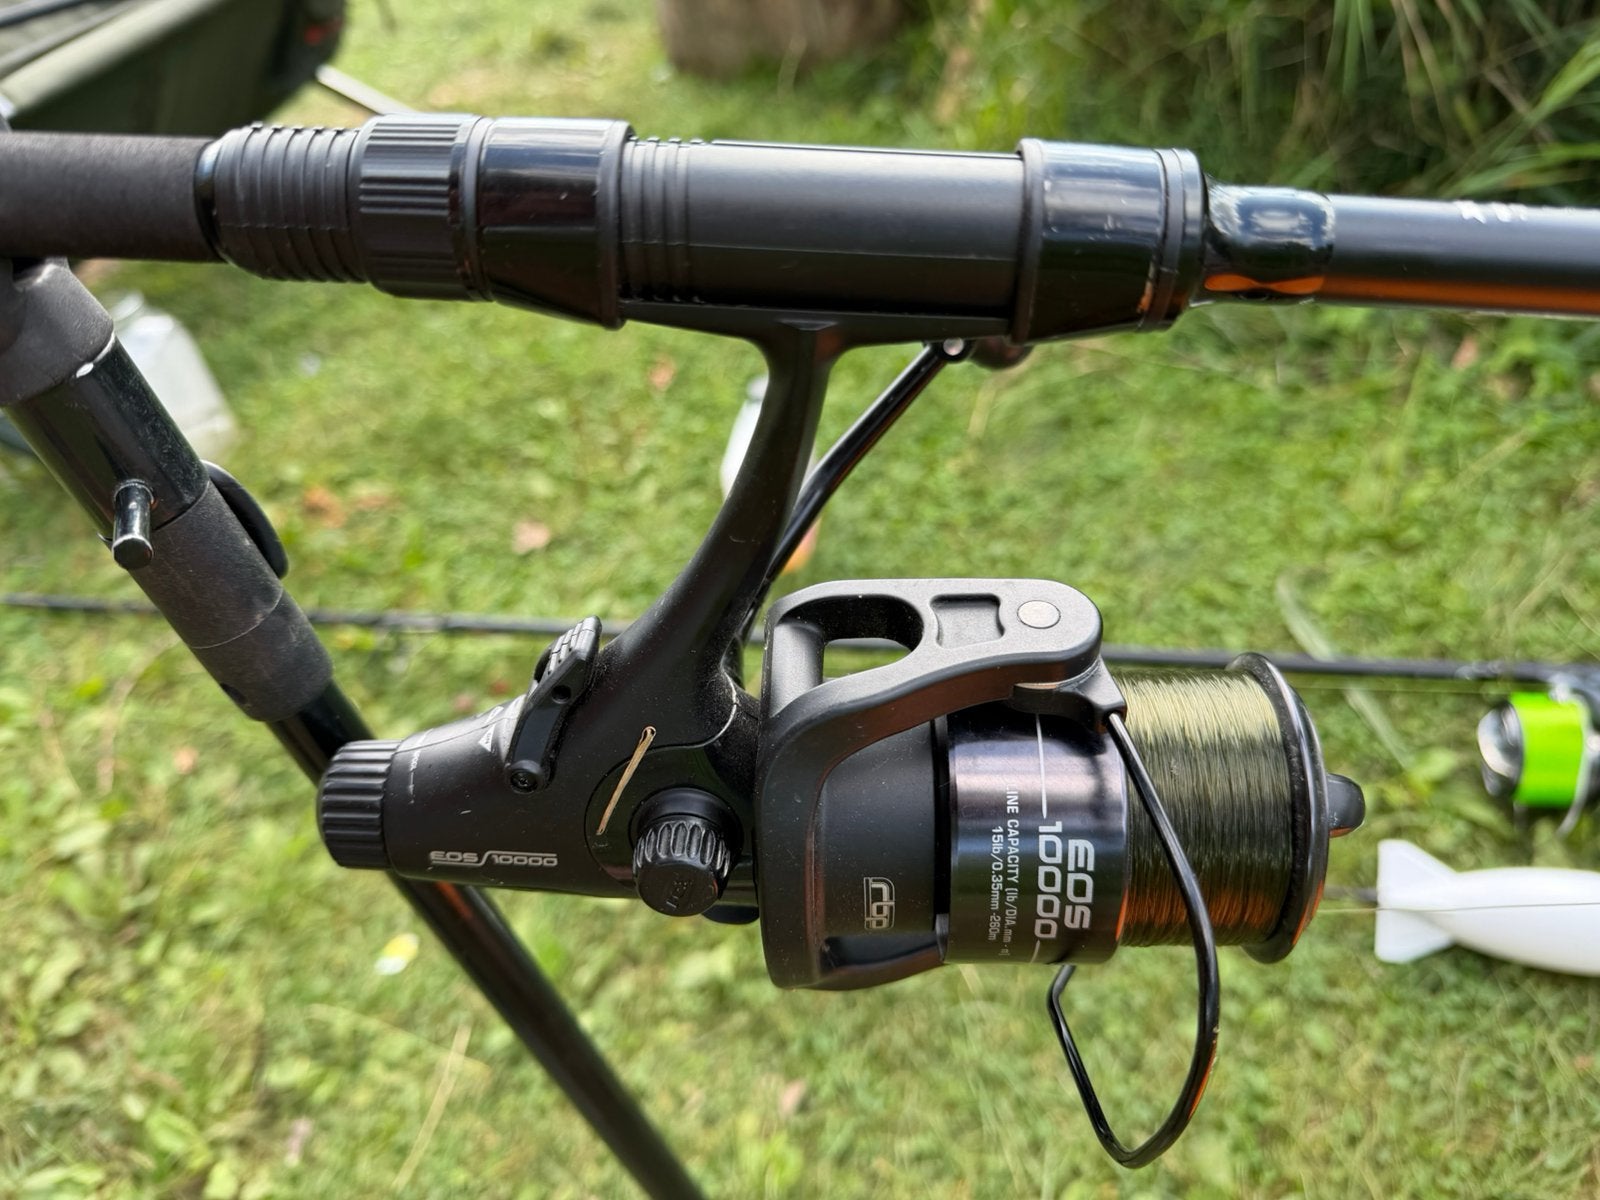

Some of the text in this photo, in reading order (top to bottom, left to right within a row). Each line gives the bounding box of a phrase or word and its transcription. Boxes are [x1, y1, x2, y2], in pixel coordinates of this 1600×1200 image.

[430, 850, 558, 867] EOS 10000
[990, 826, 1004, 910] 15lb/0.35mm
[1006, 819, 1020, 884] CAPACITY
[1034, 820, 1063, 939] 10000
[1064, 838, 1095, 929] EOS
